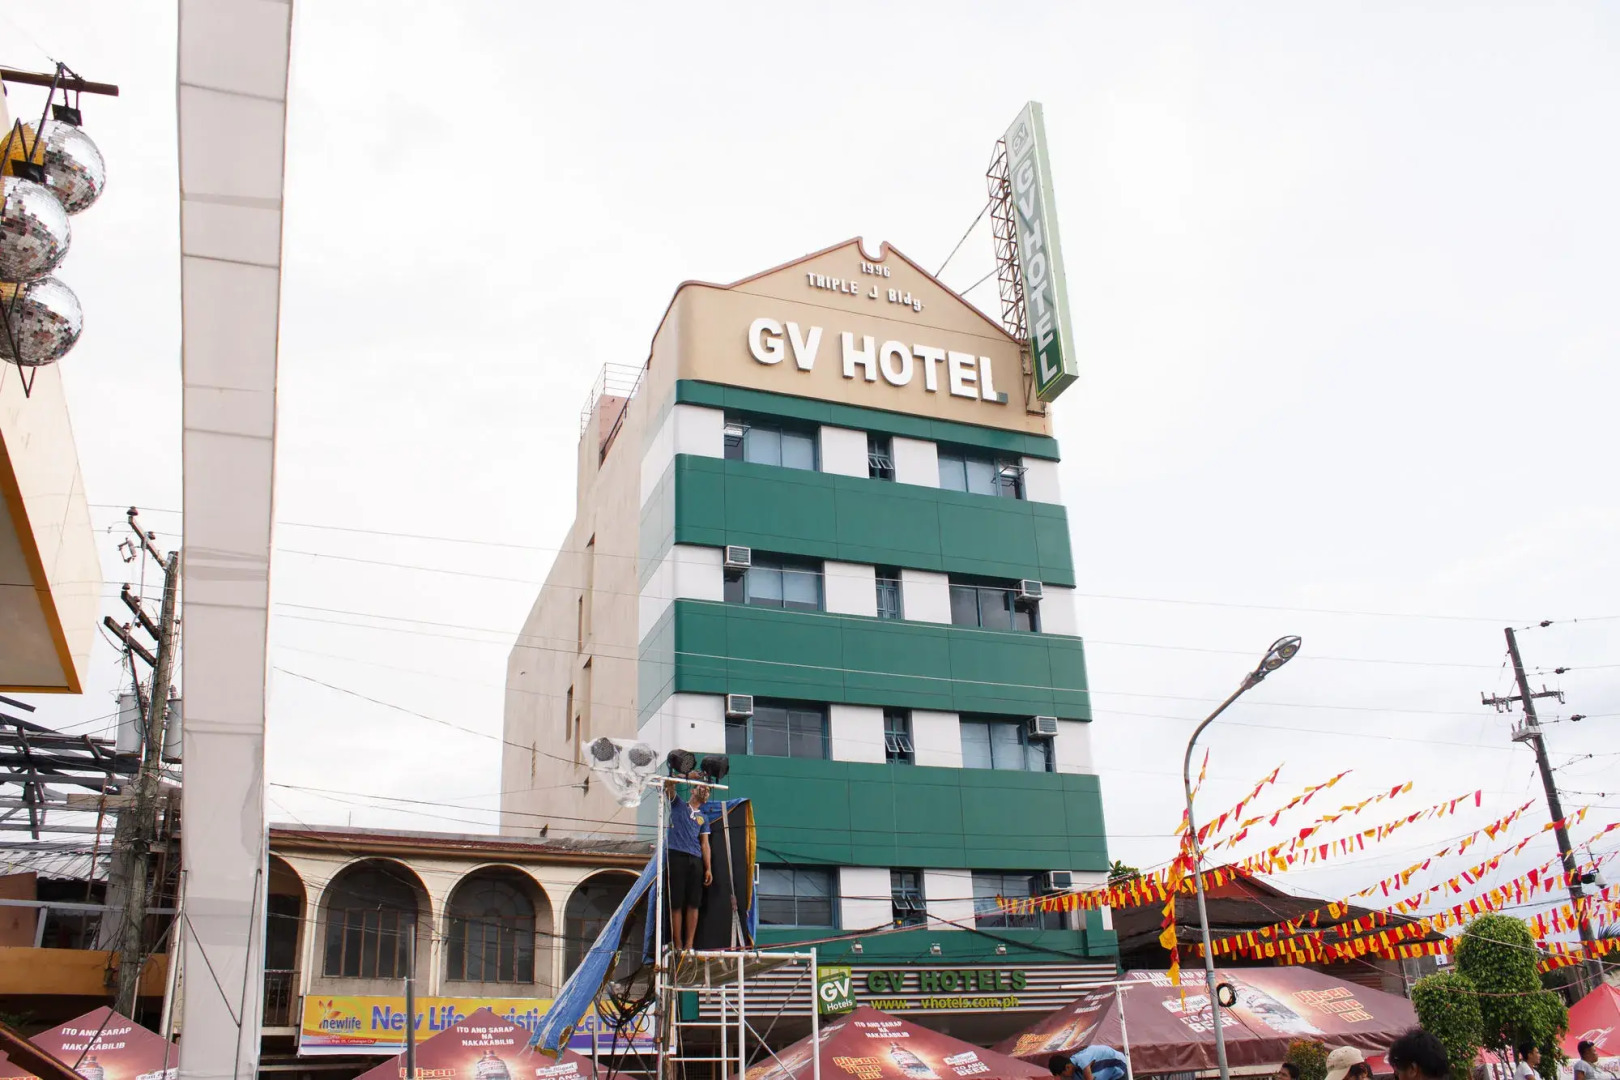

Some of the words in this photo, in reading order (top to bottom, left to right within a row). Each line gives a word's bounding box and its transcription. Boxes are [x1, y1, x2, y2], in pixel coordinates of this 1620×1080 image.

[860, 260, 891, 277] 1996
[807, 271, 859, 295] TRIPLE
[868, 284, 879, 299] J
[748, 317, 823, 372] GV
[840, 331, 1008, 405] HOTEL
[819, 977, 850, 1002] GV
[867, 970, 905, 992] GV
[920, 970, 1027, 992] HOTELS
[826, 998, 853, 1012] Hotels
[61, 1027, 77, 1035] ITO
[100, 1027, 132, 1037] SARAP
[488, 1026, 515, 1034] SARAP
[462, 1038, 515, 1047] NAKAKABILIB
